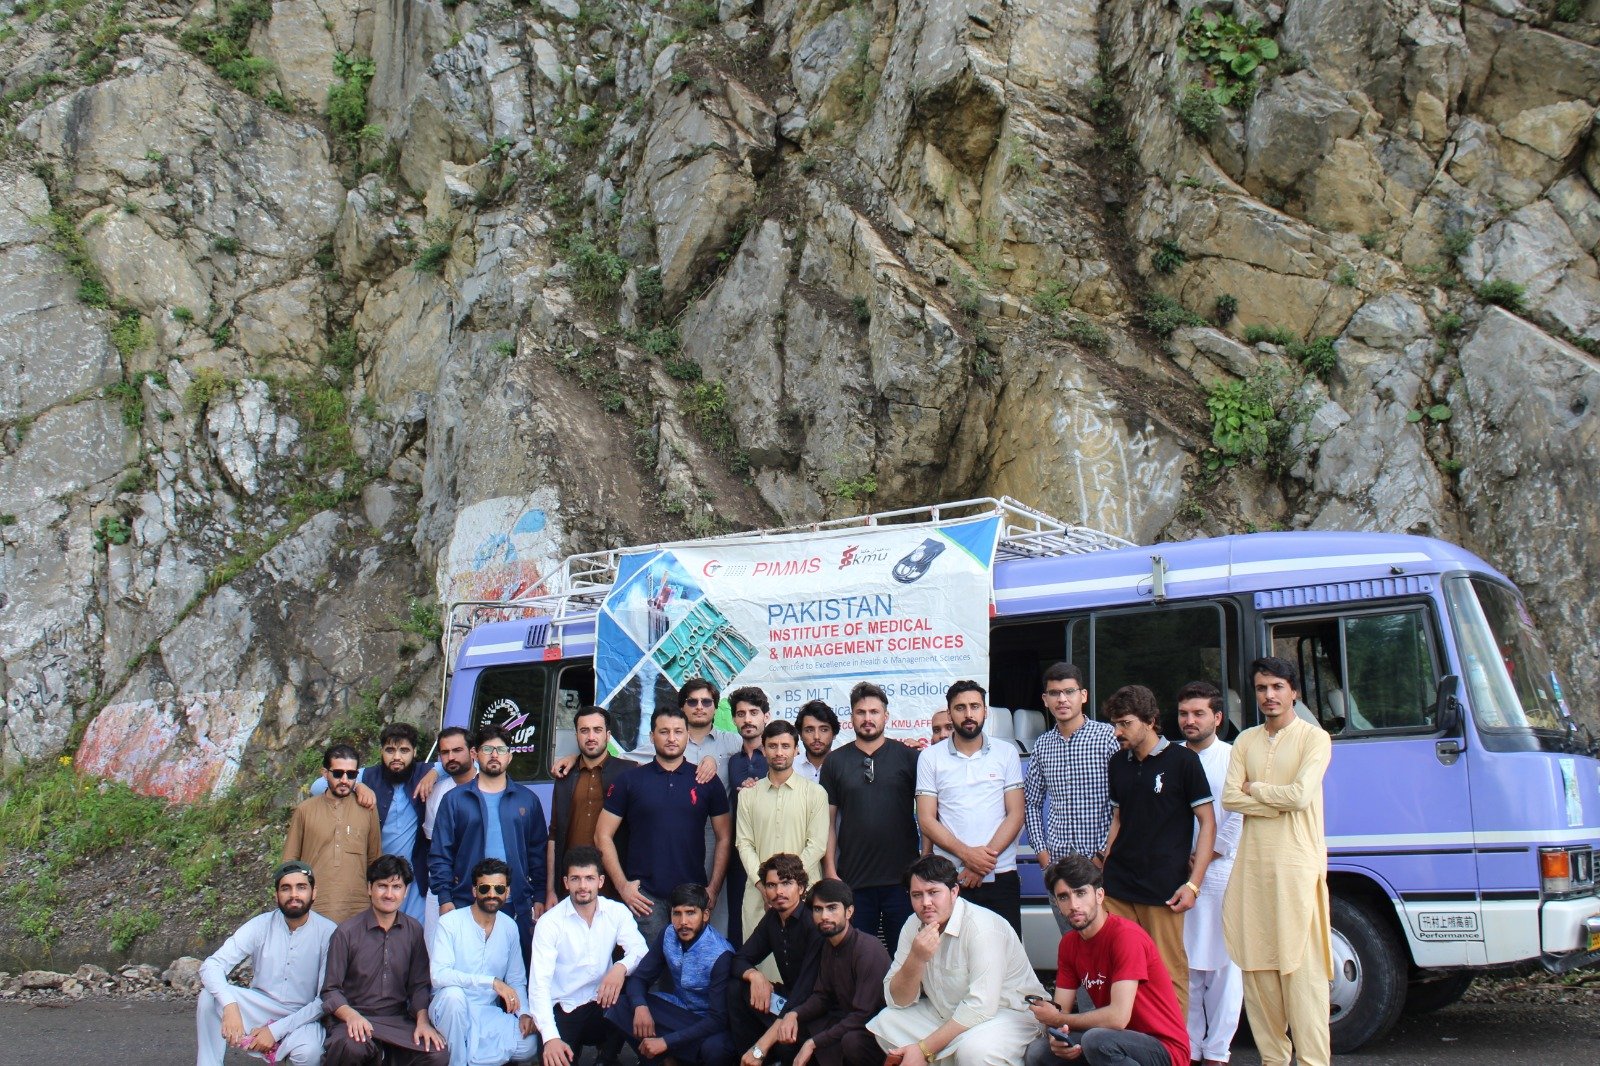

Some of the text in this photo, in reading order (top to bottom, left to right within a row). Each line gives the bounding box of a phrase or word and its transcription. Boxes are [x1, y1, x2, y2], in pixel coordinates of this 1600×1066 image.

[752, 557, 822, 577] PIMMS
[852, 553, 888, 566] kmu
[768, 594, 892, 626] PAKISTAN
[769, 618, 933, 642] INSTITUTE OF MEDICAL
[769, 634, 964, 660] & MANAGEMENT SCIENCES
[768, 653, 971, 672] Committed to Excellence in Health & Management Sciences
[785, 687, 832, 702] BS MLT
[879, 682, 951, 697] BS Radiolo
[891, 720, 912, 728] KMU
[509, 744, 535, 753] peed
